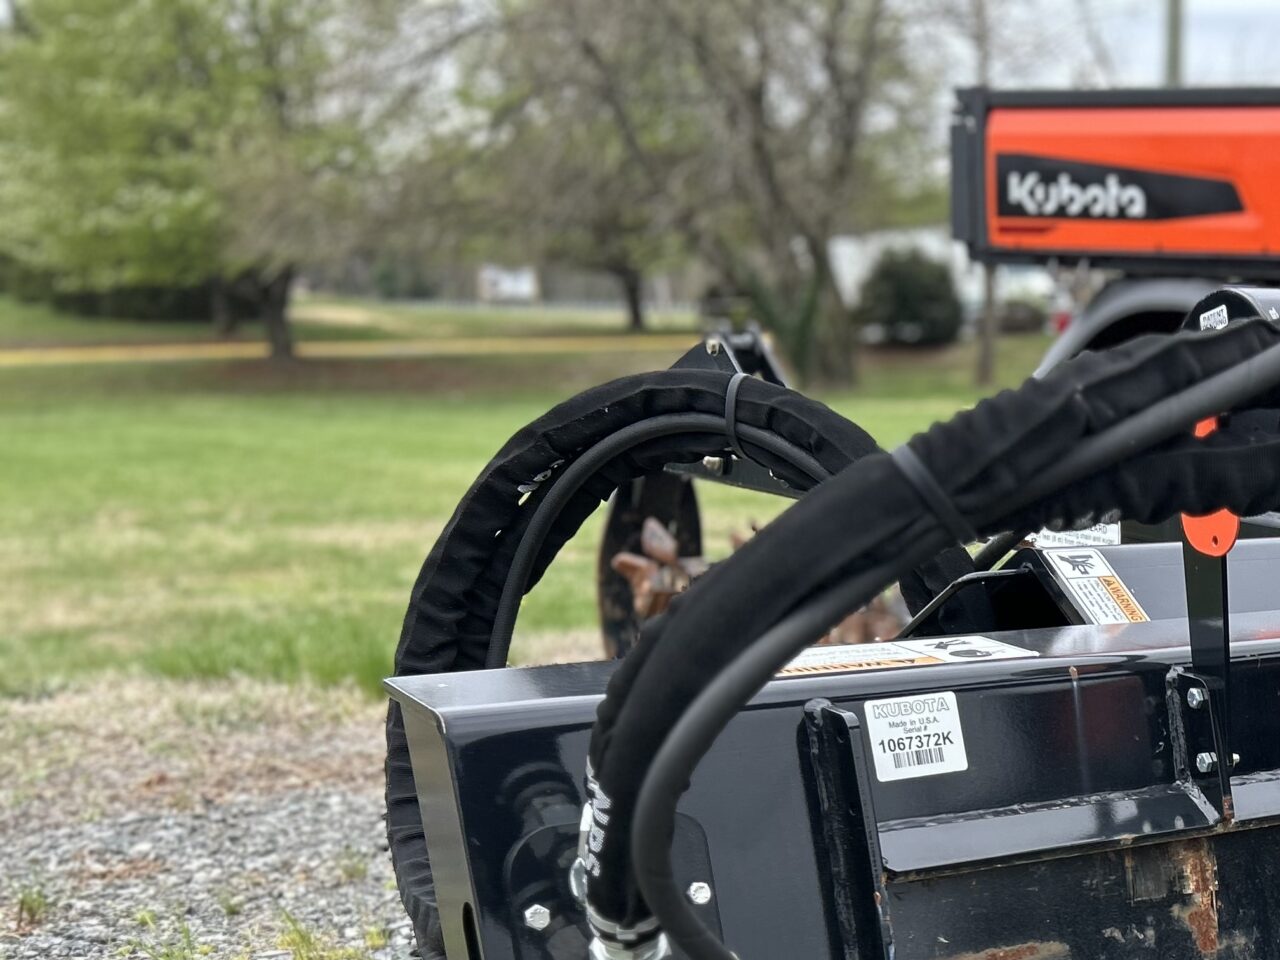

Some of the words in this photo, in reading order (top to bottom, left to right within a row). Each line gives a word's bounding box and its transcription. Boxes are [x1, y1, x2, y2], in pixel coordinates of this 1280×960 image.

[1007, 171, 1146, 218] Kubota
[1203, 308, 1224, 322] PATENT
[1110, 586, 1143, 621] WARNING
[873, 697, 949, 719] KUBOTA
[889, 720, 907, 728] Made
[879, 731, 954, 753] 1067372K
